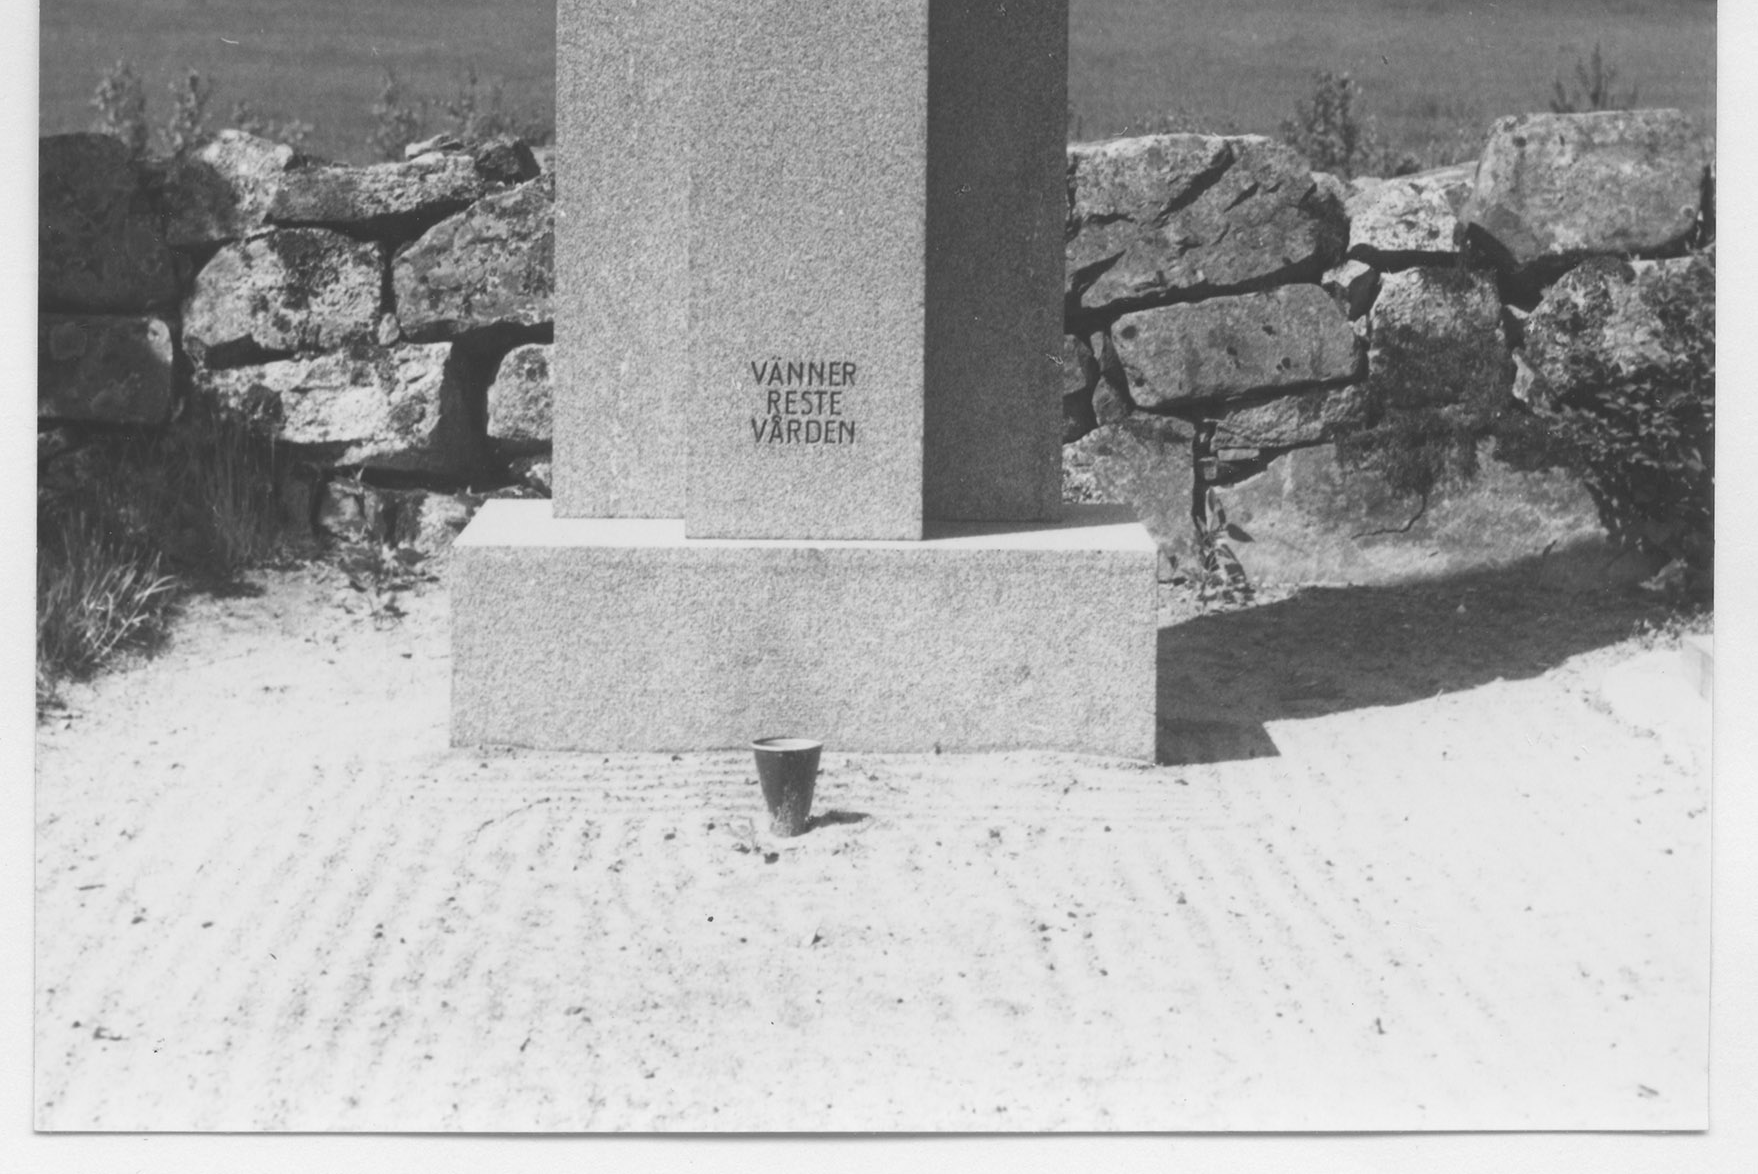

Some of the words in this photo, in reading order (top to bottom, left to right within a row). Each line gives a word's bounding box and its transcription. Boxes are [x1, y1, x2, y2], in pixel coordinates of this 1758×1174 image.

[751, 355, 857, 387] VÄNNER
[767, 390, 843, 416] RESTE
[751, 415, 856, 445] VÅRDEN
